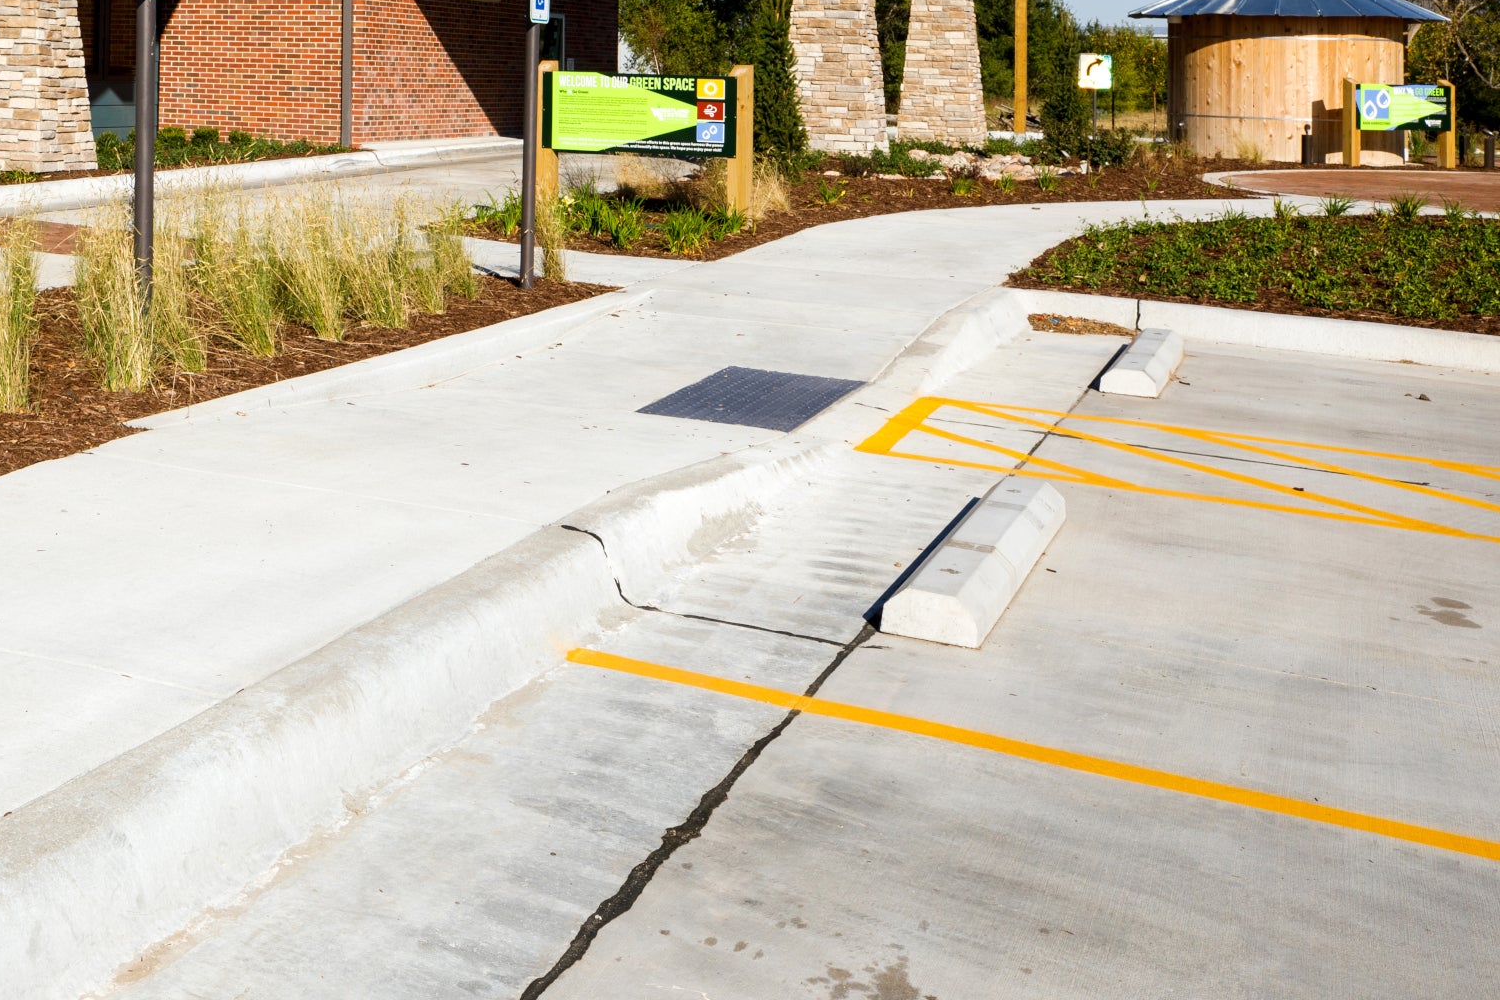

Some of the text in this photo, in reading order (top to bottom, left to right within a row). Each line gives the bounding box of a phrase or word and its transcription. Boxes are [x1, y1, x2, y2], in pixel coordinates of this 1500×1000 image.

[559, 75, 696, 92] WELCOME TO OUR GREEN SPACE
[1424, 87, 1444, 97] GREEN
